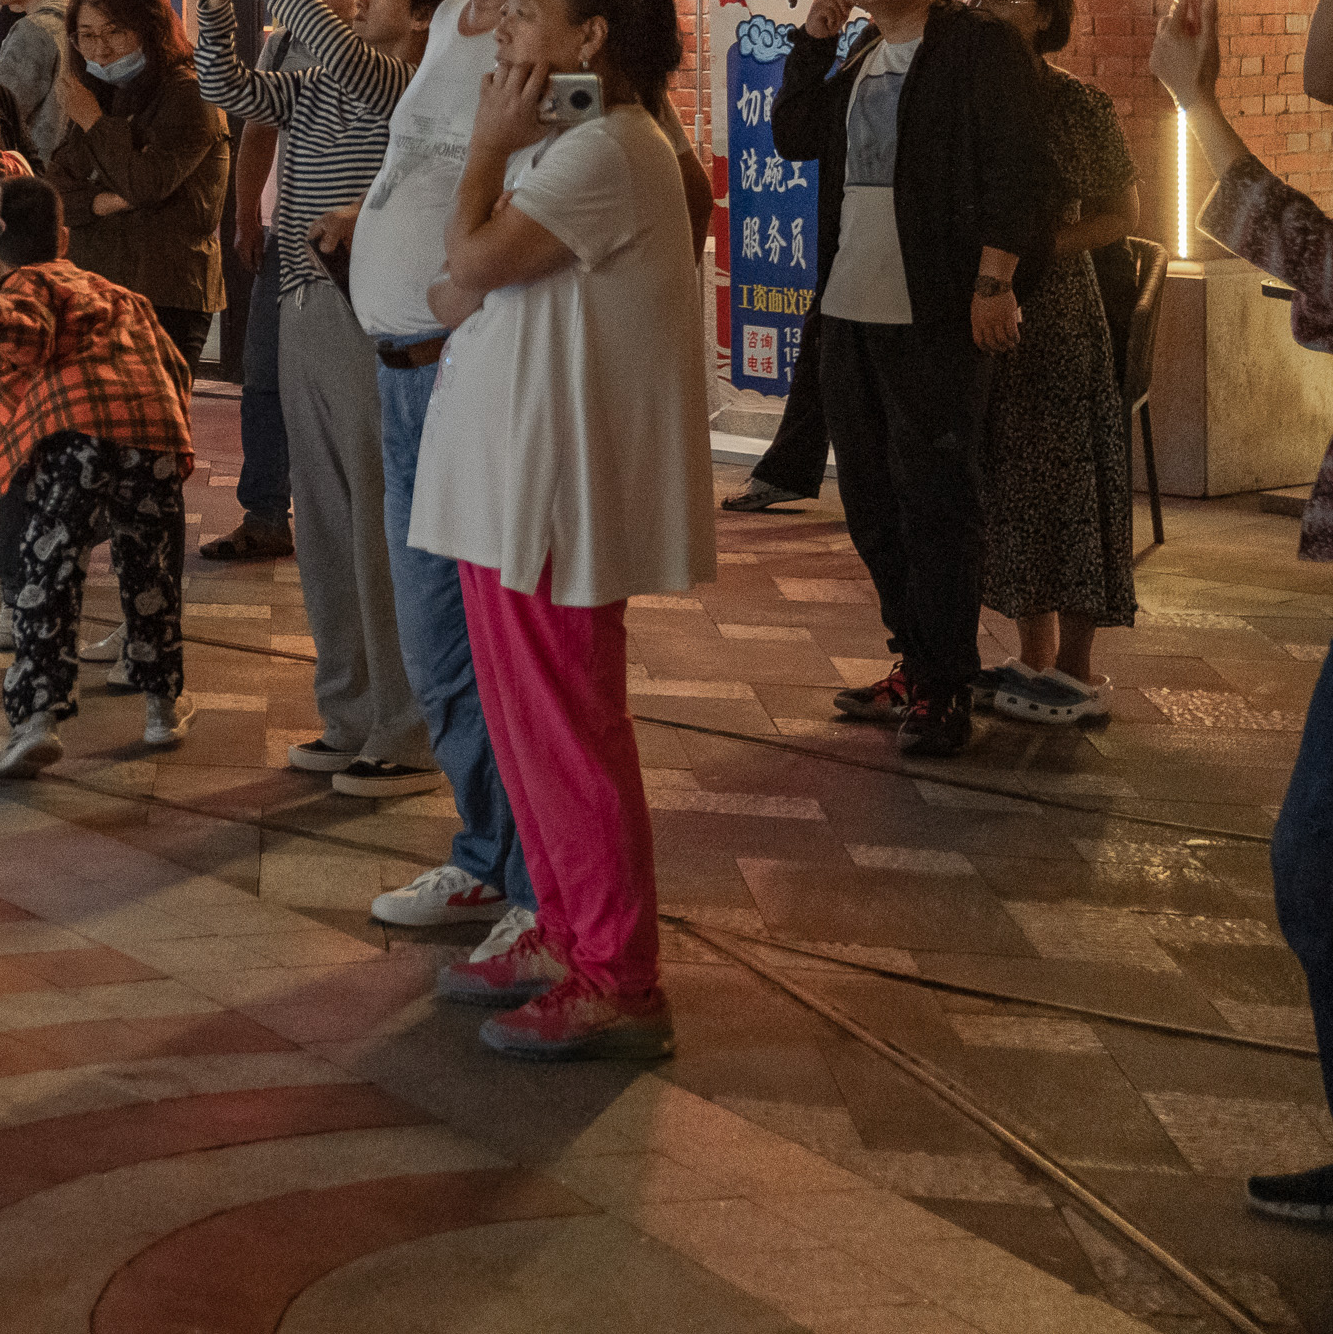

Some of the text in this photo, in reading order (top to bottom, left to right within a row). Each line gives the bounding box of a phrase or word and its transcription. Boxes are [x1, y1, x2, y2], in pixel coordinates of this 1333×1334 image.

[740, 148, 808, 193] 洗碗工
[742, 216, 807, 270] 服务员
[747, 331, 773, 350] 咨询
[747, 355, 773, 374] 电话
